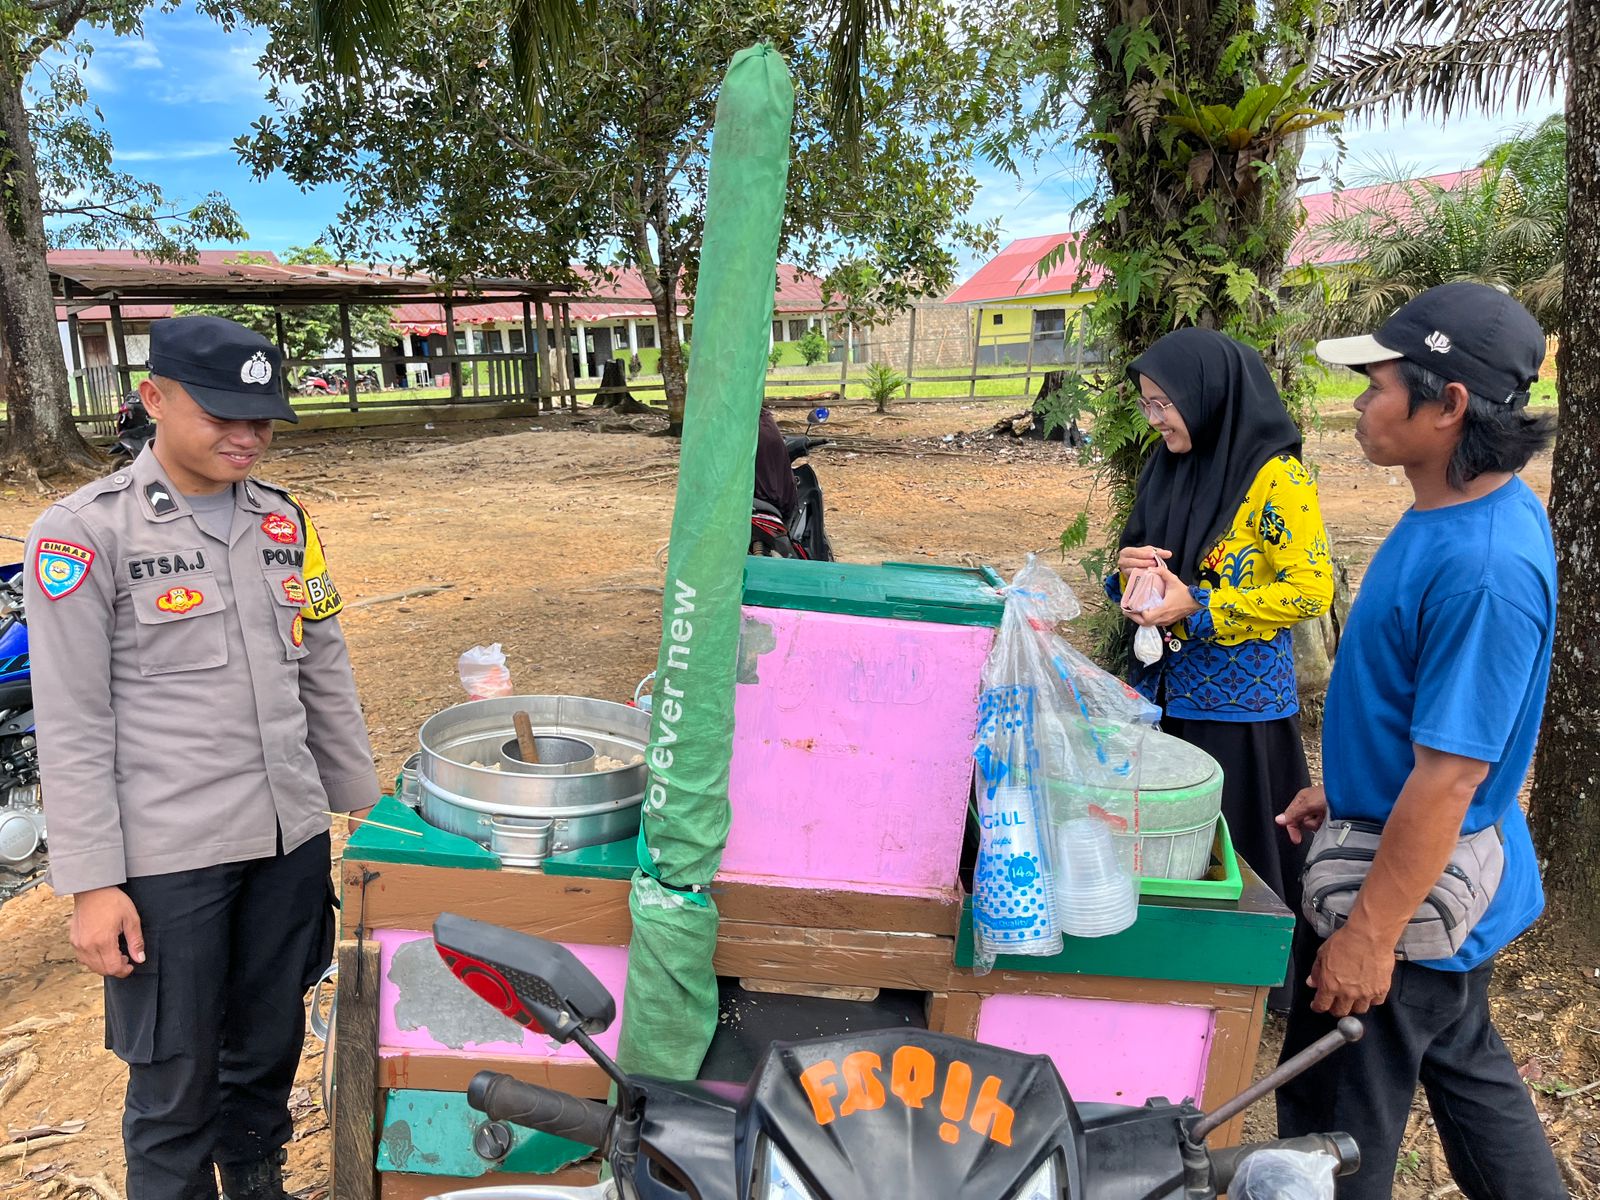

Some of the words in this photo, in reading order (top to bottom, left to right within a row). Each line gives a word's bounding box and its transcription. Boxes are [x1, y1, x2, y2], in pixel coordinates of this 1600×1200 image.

[43, 542, 87, 559] BINMAS
[128, 550, 205, 579] ETSA.J
[667, 578, 697, 670] new
[1012, 865, 1024, 878] 14
